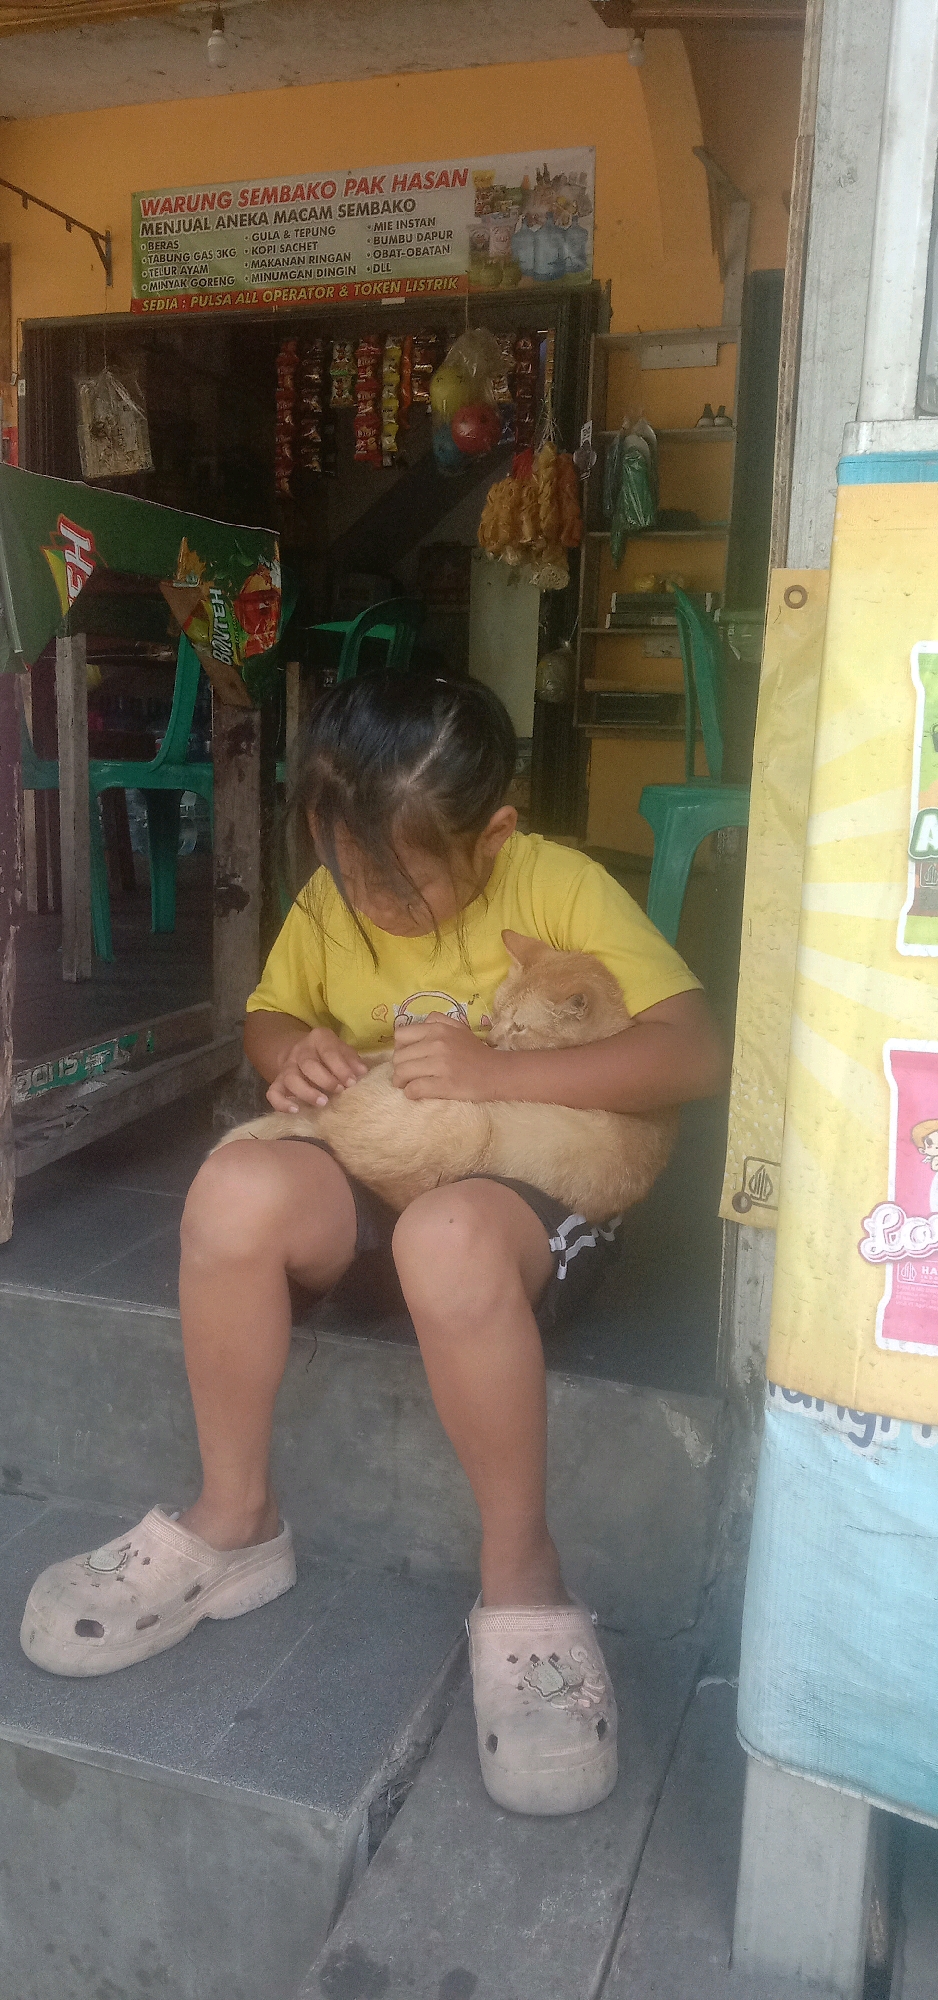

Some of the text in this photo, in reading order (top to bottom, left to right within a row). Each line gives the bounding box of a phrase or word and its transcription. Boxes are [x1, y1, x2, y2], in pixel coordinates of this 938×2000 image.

[141, 168, 469, 217] WARUNG SEMBAKO PAK HASAN
[140, 198, 416, 237] MENJUAL ANEKA MACAM SEMBAKO
[373, 217, 436, 232] MIE INSTAN
[251, 225, 337, 242] GULA & TEPUNG
[373, 230, 454, 246] BUMBU DAPUR
[147, 240, 180, 251] BERAS
[251, 241, 319, 256] KOPI SACHET
[373, 244, 451, 259] OBAT-OBATAN
[148, 248, 237, 264] TABUNG GAS 3KG
[250, 252, 351, 269] MAKANAN RINGAN
[149, 264, 210, 278] TELUR AYAM
[250, 265, 357, 283] MINUMGAN DINGIN
[372, 263, 392, 274] DLL
[149, 276, 235, 292] MINYAK GORENG
[141, 298, 179, 313] SEDIA
[190, 293, 232, 308] PULSA
[234, 291, 259, 305] ALL
[262, 285, 335, 303] OPERATOR
[338, 284, 349, 298] &
[354, 280, 401, 297] TOKEN
[405, 277, 459, 293] LISTRIK
[60, 521, 95, 606] EH
[209, 587, 234, 666] BONTEH
